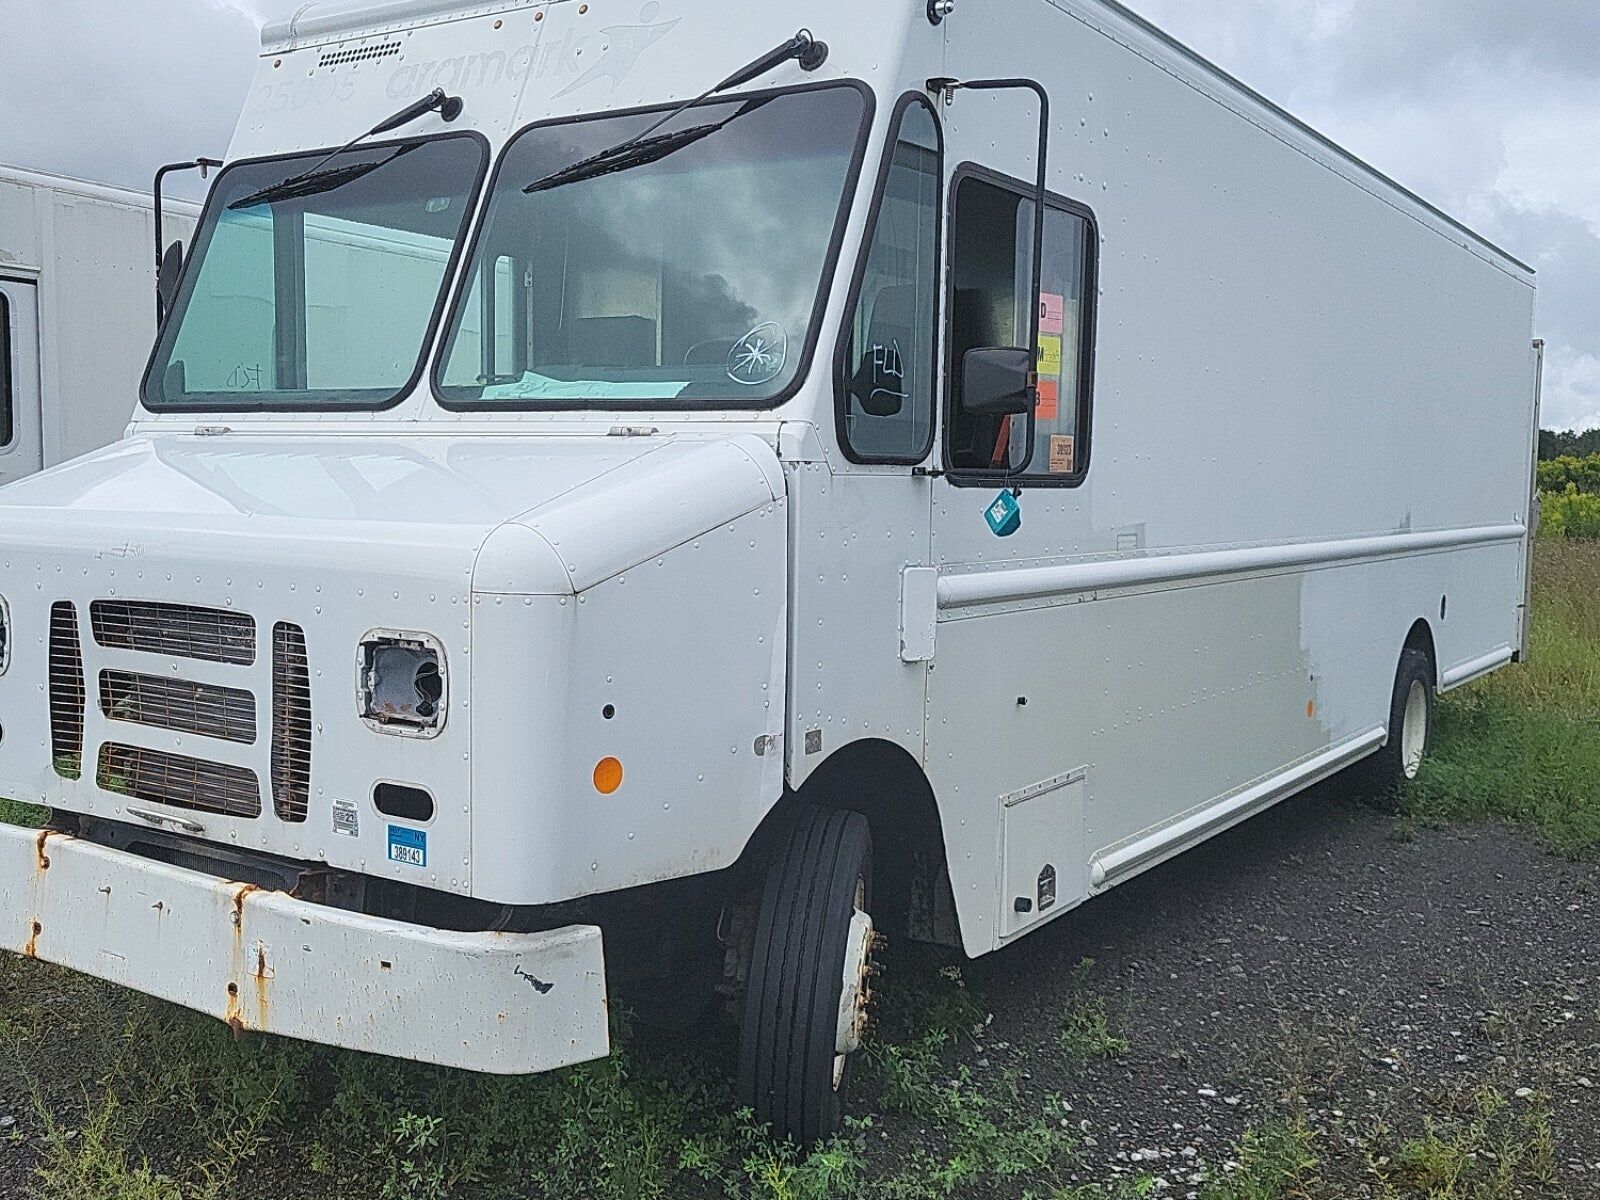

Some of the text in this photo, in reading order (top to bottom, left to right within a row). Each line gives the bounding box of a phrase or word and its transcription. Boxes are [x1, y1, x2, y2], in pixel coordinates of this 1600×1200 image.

[385, 27, 590, 99] aramark
[414, 831, 425, 843] NY
[394, 845, 420, 864] 389143
